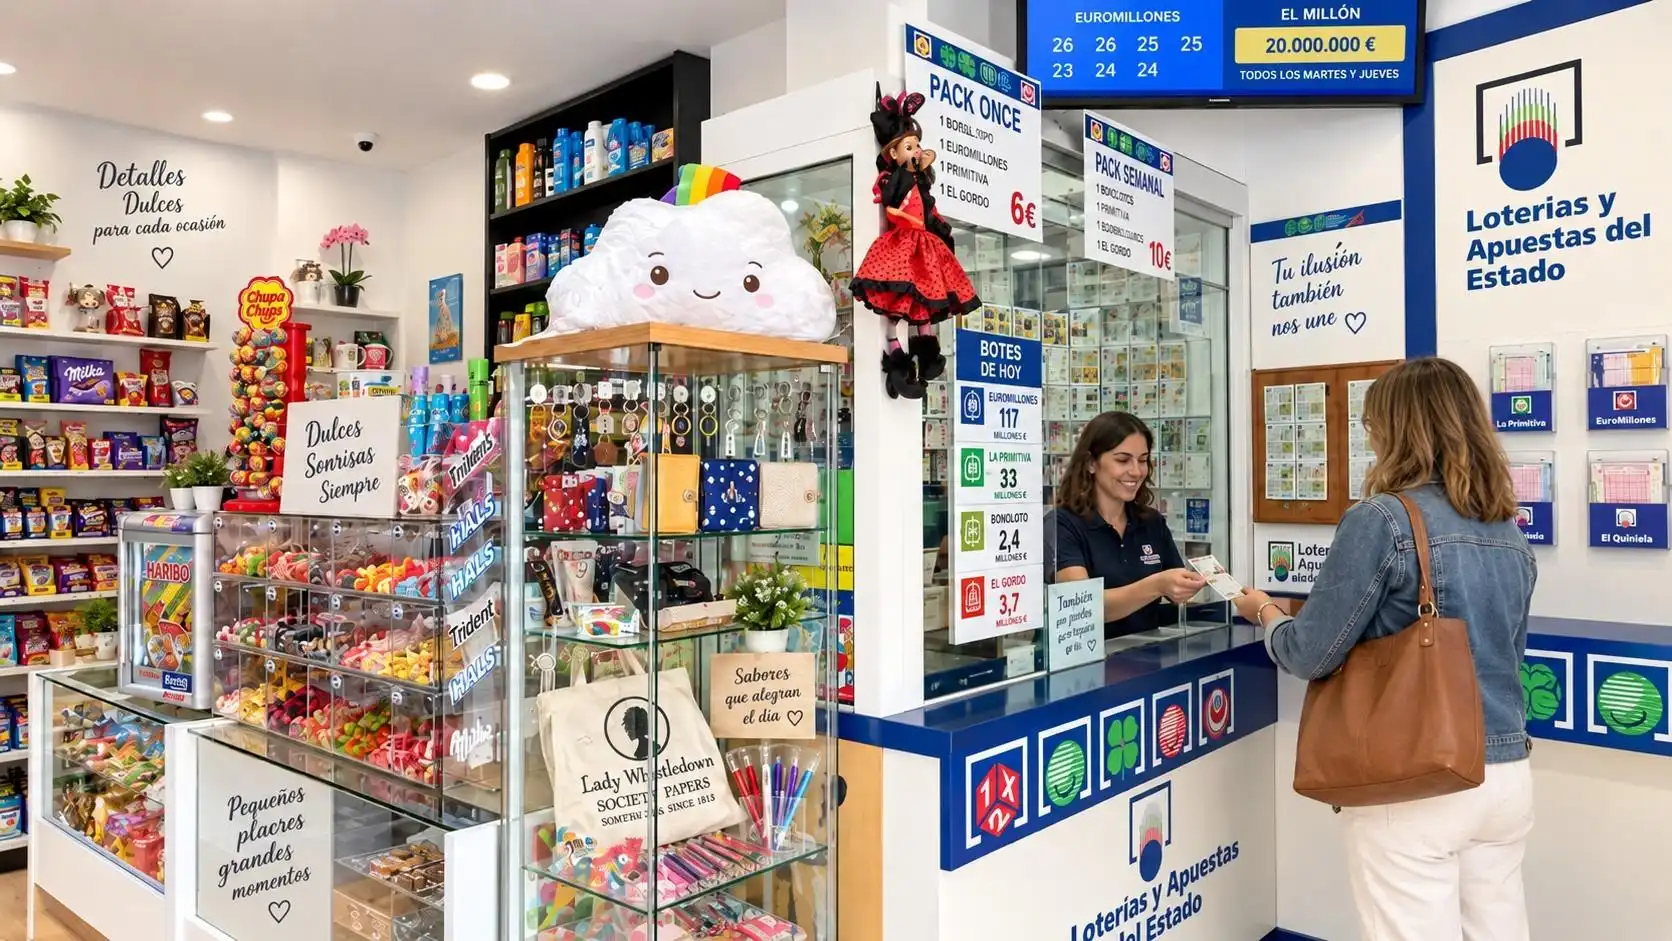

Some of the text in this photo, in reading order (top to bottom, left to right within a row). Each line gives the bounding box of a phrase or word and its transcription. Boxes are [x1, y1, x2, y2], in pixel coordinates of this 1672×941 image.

[1075, 11, 1180, 23] EUROMILLONES
[1281, 5, 1360, 21] EL MILLÓN
[1052, 36, 1203, 53] 26 26 25 25
[1265, 37, 1376, 54] 20.000.000 €
[1052, 63, 1158, 78] 23 24 24
[1240, 69, 1399, 81] TODOS LOS MARTES Y JUEVES
[930, 73, 1022, 133] PACK ONCE
[946, 140, 1008, 171] EUROMILLONES
[97, 160, 186, 189] Detalles
[947, 162, 989, 186] PRIMITIVA
[1095, 152, 1164, 198] PACK SEMANAL
[123, 191, 183, 215] Dulces
[947, 185, 957, 199] EL
[960, 189, 989, 208] GORDO
[1598, 192, 1616, 218] y
[1011, 191, 1036, 228] 6€
[93, 214, 226, 245] para cada ocasión
[1466, 213, 1651, 265] Apuestas del
[1102, 241, 1109, 252] EL
[1150, 241, 1171, 270] 10€
[1272, 241, 1363, 285] Tu ilusión
[1467, 258, 1566, 291] Estado
[247, 290, 285, 305] Chupa
[1272, 280, 1344, 310] también
[246, 304, 283, 319] Chups
[1272, 312, 1337, 337] nos une
[980, 339, 1022, 361] BOTES
[64, 365, 105, 382] Milka
[981, 362, 1021, 380] DE HOY
[989, 392, 1038, 405] EUROMILLONES
[999, 408, 1019, 429] 117
[1508, 418, 1546, 428] Primitiva
[1596, 416, 1656, 425] EuroMillones
[305, 415, 363, 448] Dulces
[994, 431, 1027, 440] MILLONES €
[304, 446, 376, 479] Sonrisas
[989, 452, 1032, 463] LA PRIMITIVA
[319, 475, 381, 504] Siempre
[1000, 468, 1017, 488] 33
[994, 491, 1027, 500] MILLONES €
[991, 512, 1029, 525] BONOLOTO
[999, 529, 1020, 553] 2,4
[1298, 543, 1330, 556] Loter
[1601, 534, 1611, 542] El
[451, 540, 495, 600] HALS
[995, 554, 1022, 563] MILLONES
[146, 561, 190, 583] HARIBO
[991, 574, 1026, 589] EL GORDO
[999, 592, 1019, 616] 3,7
[449, 600, 495, 649] Trident
[451, 647, 496, 704] HALS
[734, 667, 791, 686] Sabores
[725, 686, 802, 710] que alegran
[742, 709, 755, 725] el
[581, 755, 715, 794] Lady Whstledown
[664, 777, 711, 798] PAPERS
[980, 769, 1016, 808] 1 X
[227, 785, 305, 821] Pequeños
[987, 807, 1011, 834] 2
[218, 841, 295, 888] grandes
[1152, 883, 1162, 912] y
[1167, 840, 1240, 898] Apuestas
[232, 866, 312, 900] momentos
[1146, 891, 1203, 941] Estado
